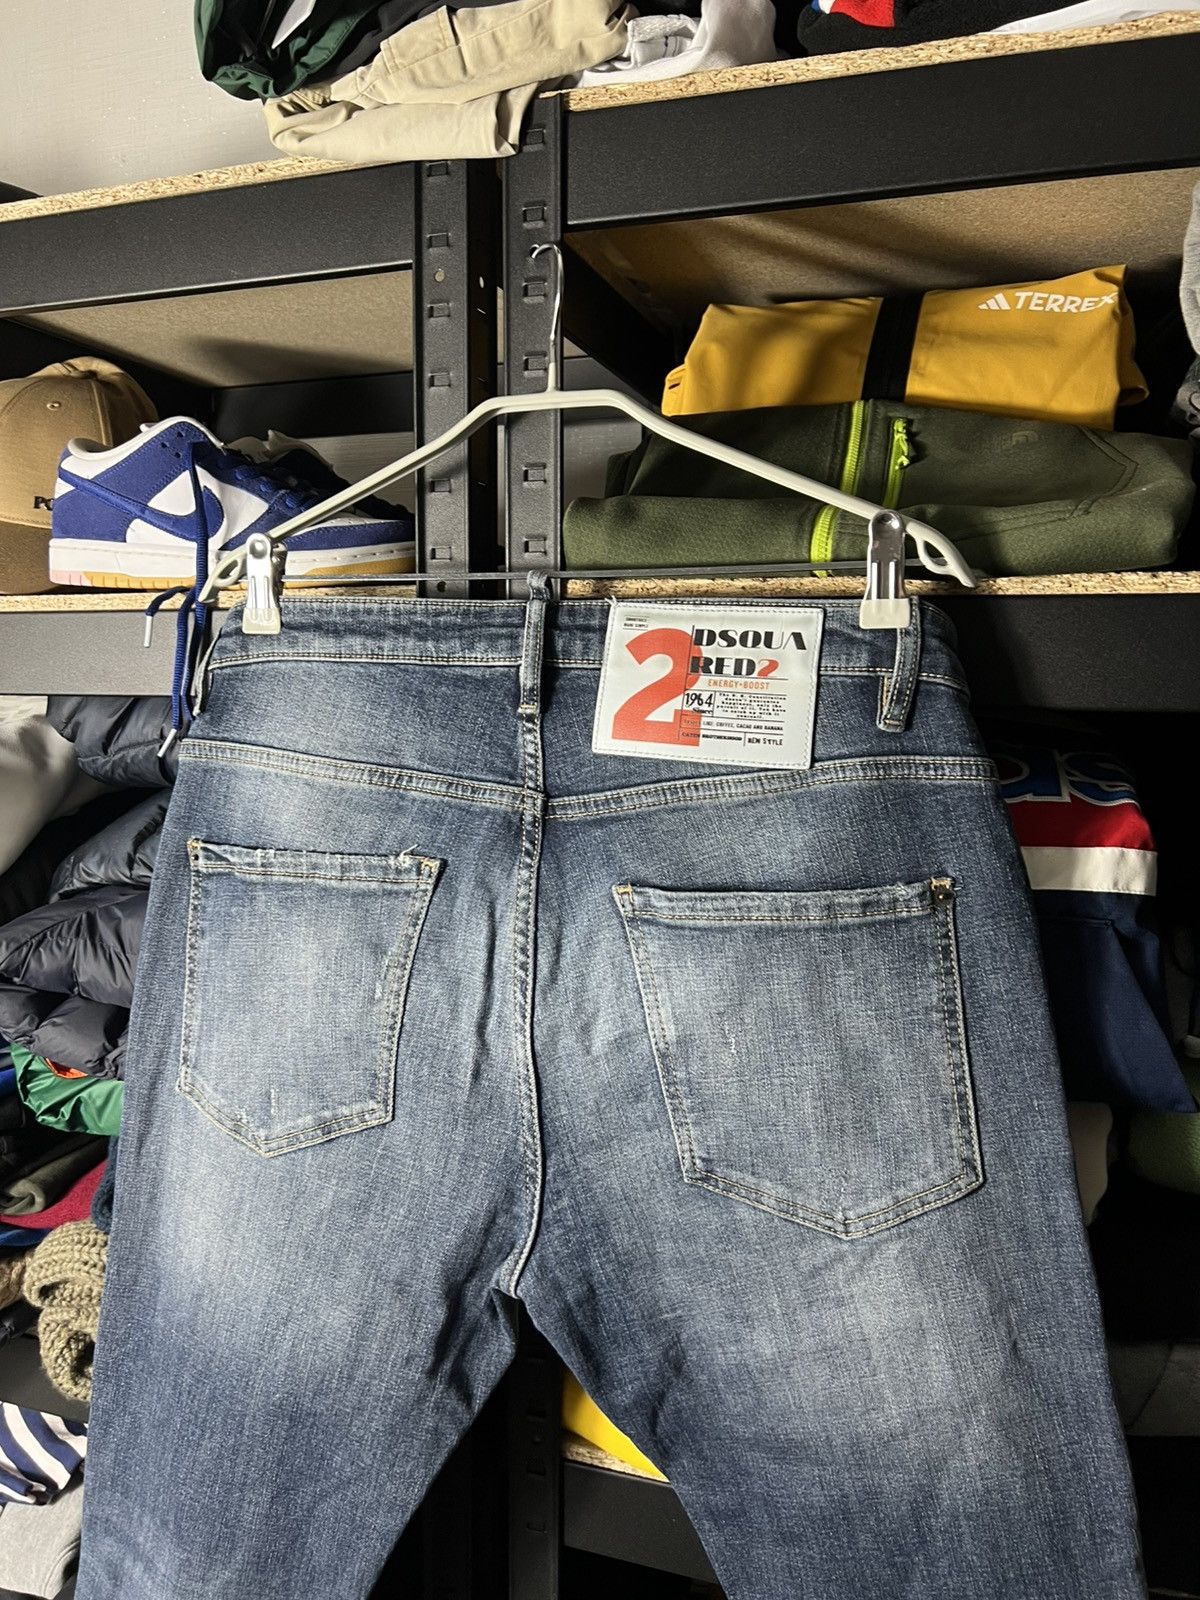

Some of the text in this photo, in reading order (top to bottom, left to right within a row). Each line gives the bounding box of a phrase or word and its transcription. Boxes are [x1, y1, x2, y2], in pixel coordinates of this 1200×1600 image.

[1014, 290, 1119, 313] TERREX
[693, 628, 807, 650] DSQUA
[685, 692, 714, 708] 1964
